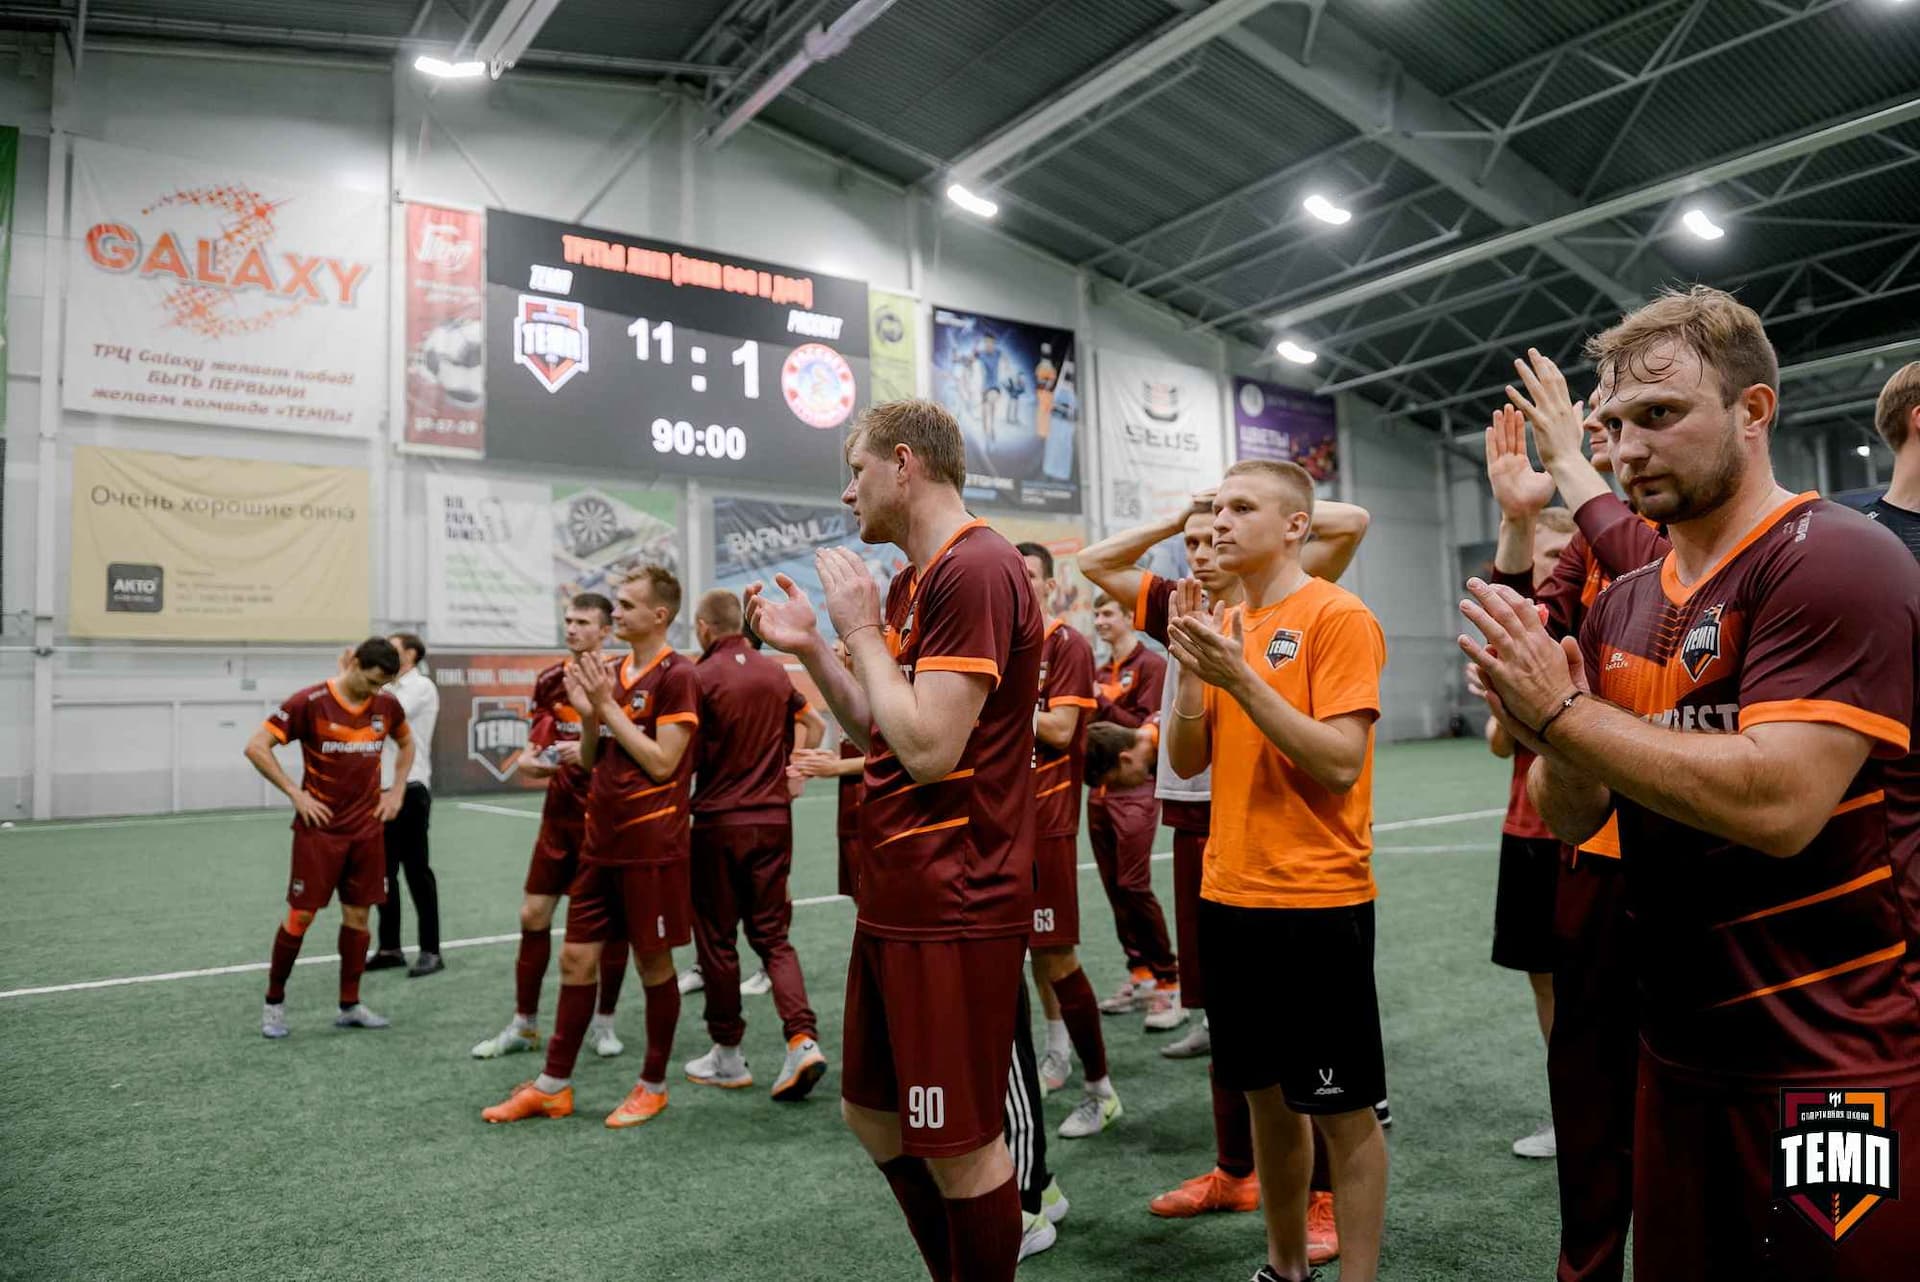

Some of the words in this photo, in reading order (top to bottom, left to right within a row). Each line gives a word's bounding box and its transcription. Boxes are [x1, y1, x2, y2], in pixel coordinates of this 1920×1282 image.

[86, 223, 369, 305] GALAXY
[94, 343, 131, 363] ТРЦ
[138, 350, 204, 371] Galaxy
[627, 318, 674, 364] 11
[732, 340, 759, 399] 1
[147, 370, 203, 390] БЫТЬ
[209, 377, 306, 399] ПЕРВЫМИ
[182, 397, 269, 415] команде
[652, 418, 747, 460] 90:00
[91, 485, 174, 511] Очень
[181, 499, 293, 519] хорошие
[299, 505, 355, 522] окна
[727, 519, 828, 557] BARNAUL
[1268, 638, 1298, 658] ТЕМП
[1685, 625, 1718, 653] ТЕМП
[1033, 907, 1055, 932] 63
[908, 1086, 944, 1129] 90
